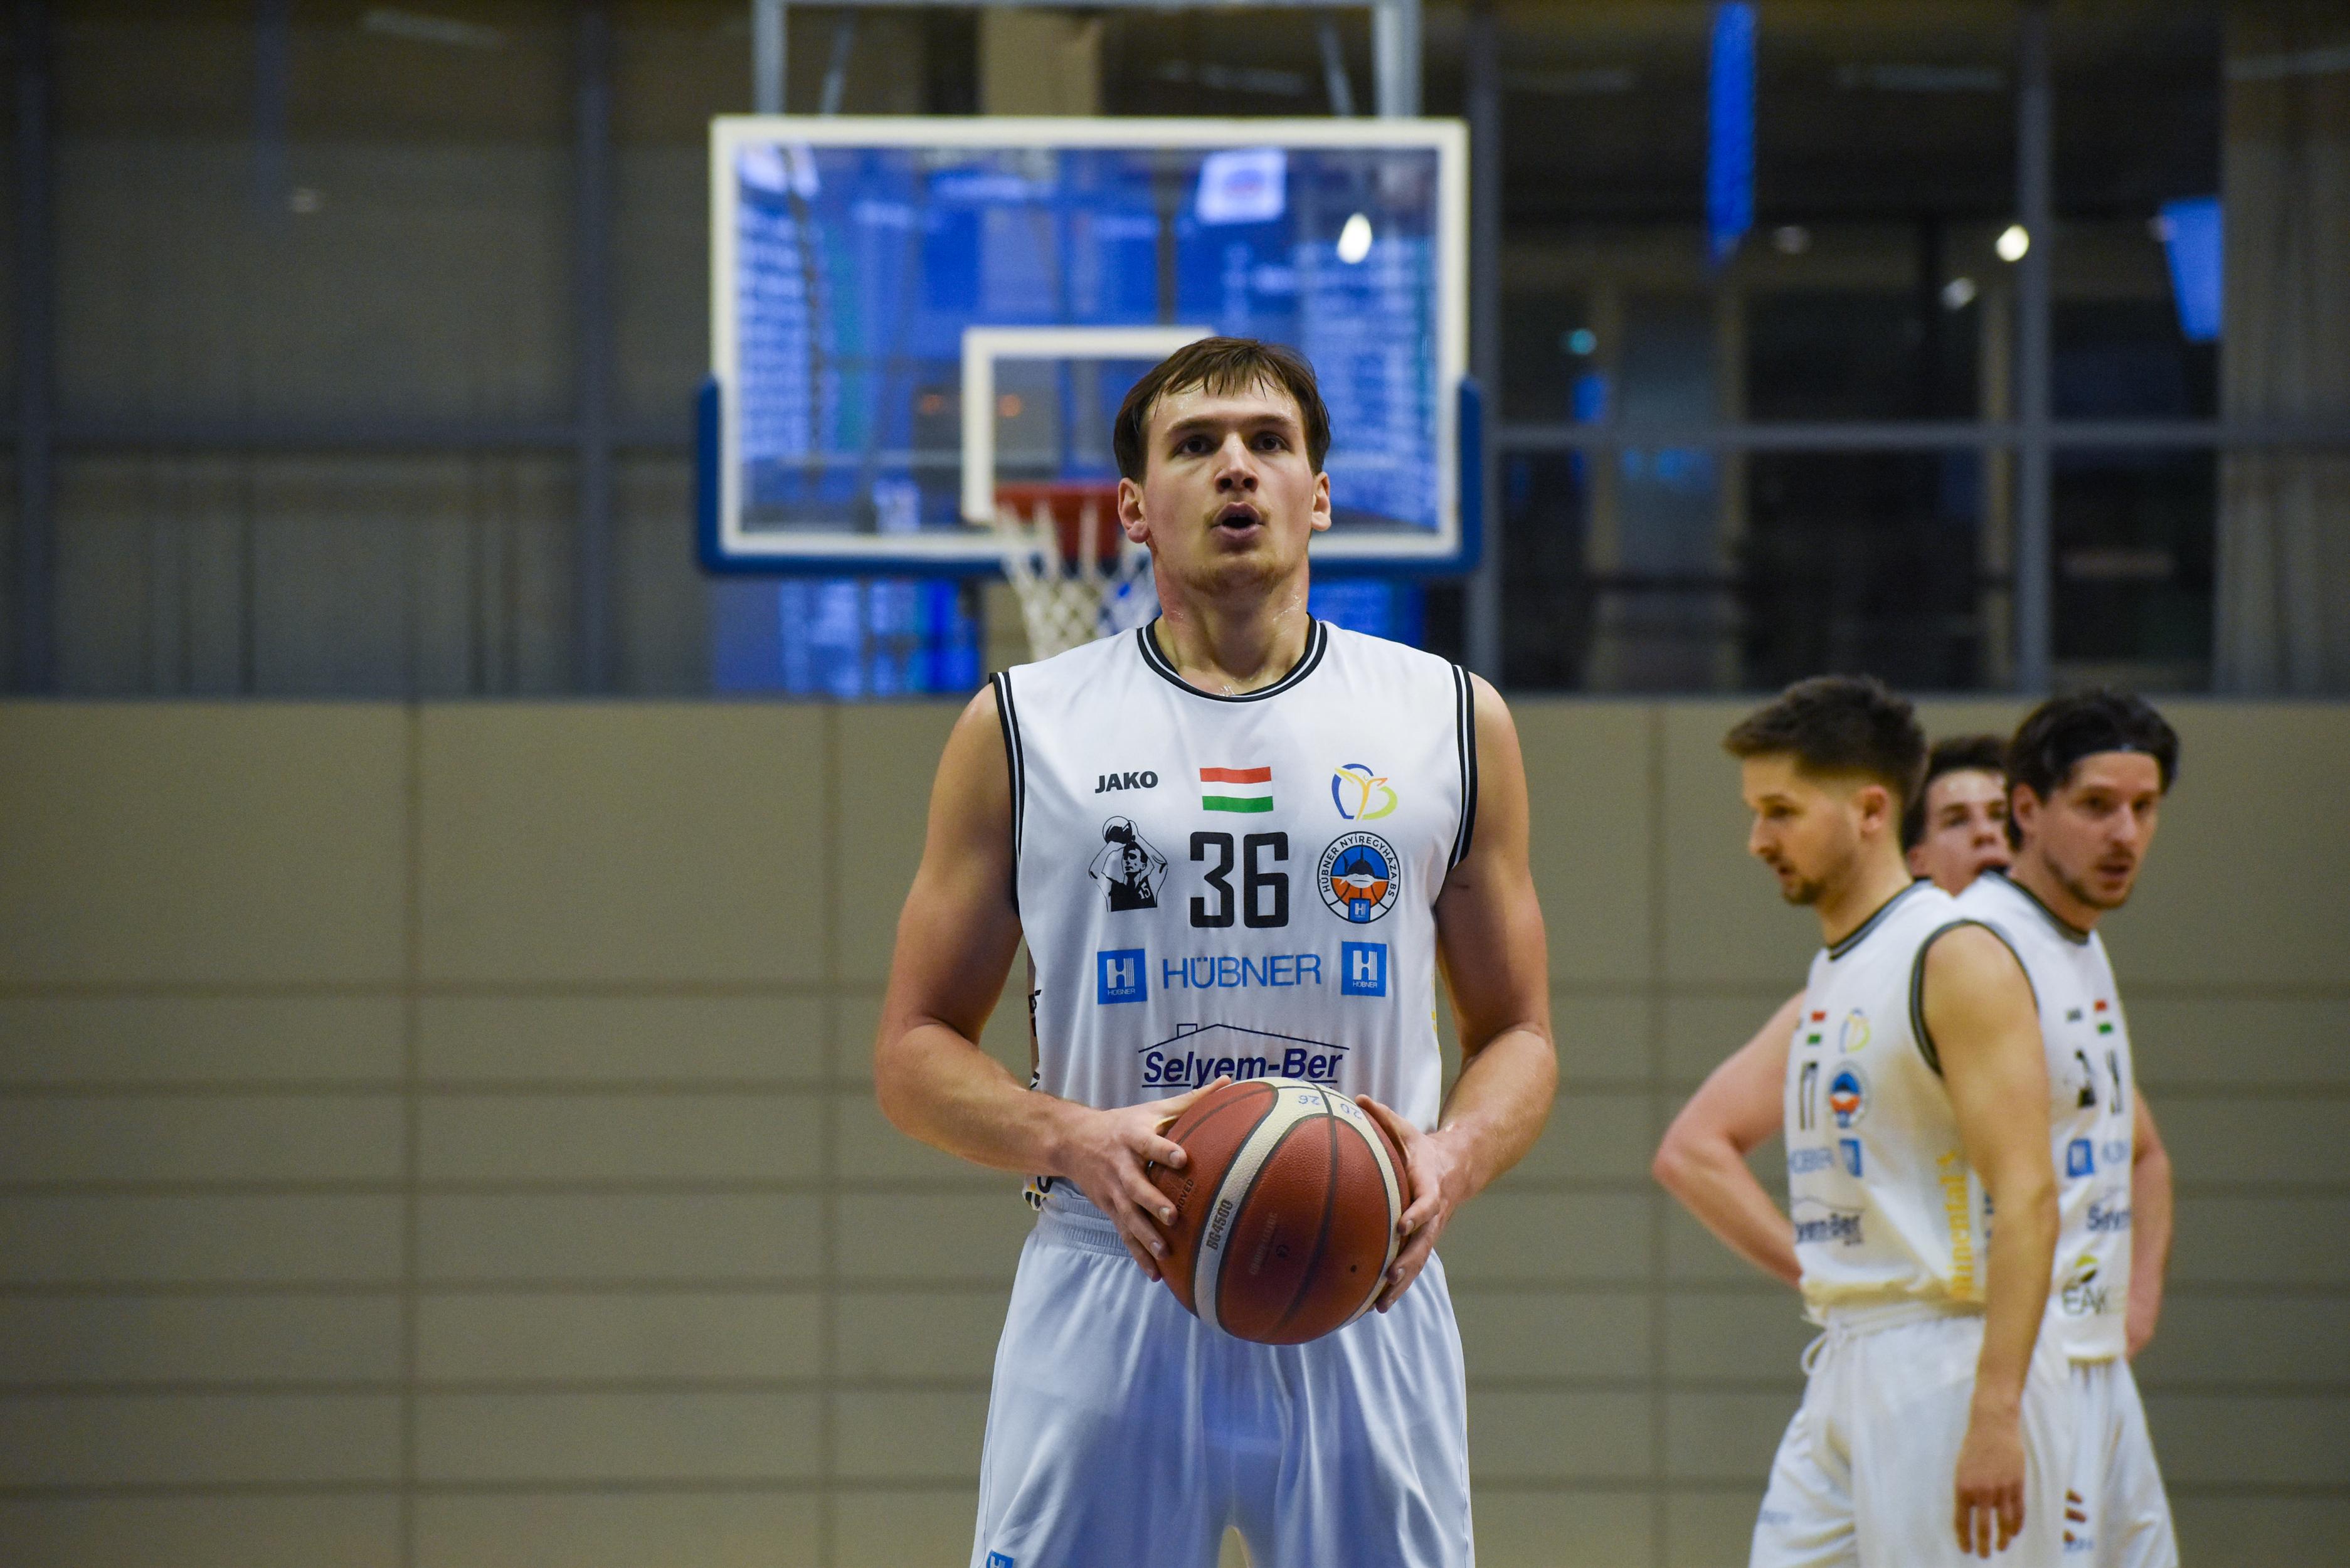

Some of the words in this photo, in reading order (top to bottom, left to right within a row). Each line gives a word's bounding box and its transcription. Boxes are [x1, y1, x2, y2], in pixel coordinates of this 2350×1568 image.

[1094, 770, 1159, 794] JAKO
[1190, 831, 1289, 928] 36
[1319, 847, 1340, 893] HÜBNER
[1340, 833, 1397, 880] NYÍREGYHÁZA
[1387, 882, 1397, 898] BS
[1138, 880, 1151, 900] 15
[1162, 953, 1322, 989] HÜBNER
[1143, 1048, 1343, 1089] Selyem-Ber
[1298, 1094, 1320, 1106] 26
[1205, 1199, 1234, 1251] BG4500
